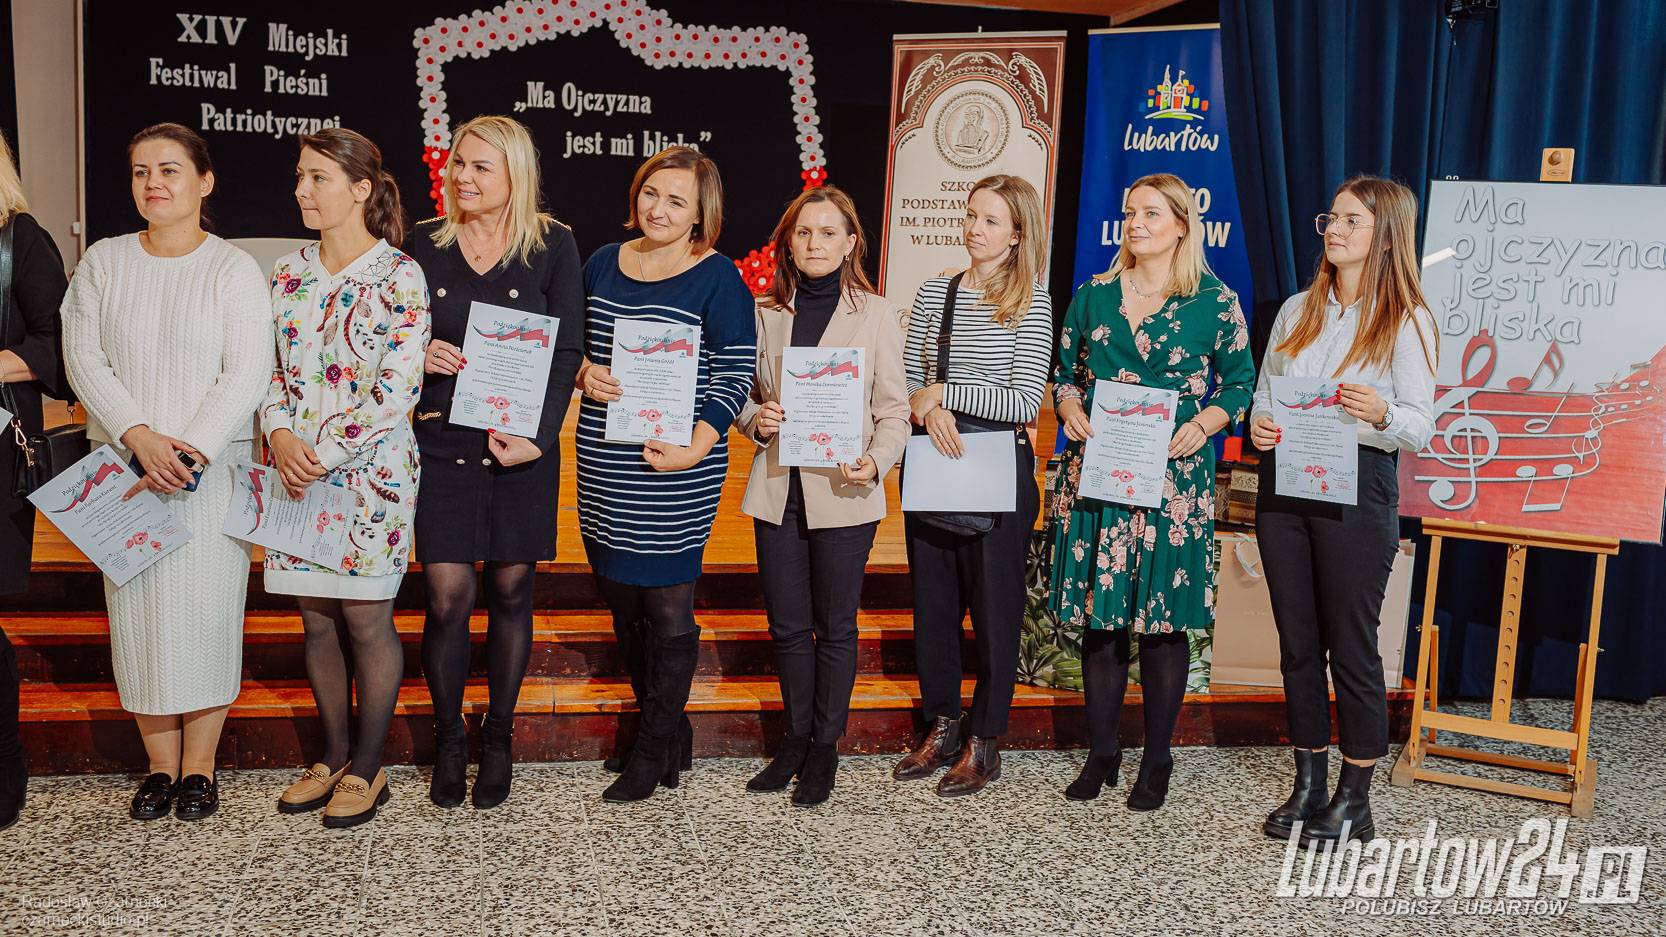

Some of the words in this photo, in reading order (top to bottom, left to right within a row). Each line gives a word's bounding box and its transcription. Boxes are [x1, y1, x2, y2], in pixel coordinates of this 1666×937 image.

[176, 13, 247, 46] XIV
[268, 22, 348, 61] Miejski
[150, 58, 237, 90] Festiwal
[264, 65, 328, 97] Pieśni
[562, 82, 652, 117] Ojczyzna
[563, 131, 603, 158] jest
[610, 133, 635, 156] mi
[1124, 123, 1219, 152] Lubartów
[902, 198, 968, 210] PODSTAW
[940, 181, 976, 192] SZKO
[900, 217, 919, 228] IM.
[923, 217, 965, 228] PIOTR
[1455, 185, 1526, 225] Ma
[911, 235, 924, 246] W
[1451, 224, 1666, 277] ojczyzna
[1449, 261, 1546, 310] jest
[1562, 269, 1618, 307] mi
[1441, 297, 1582, 345] bliska
